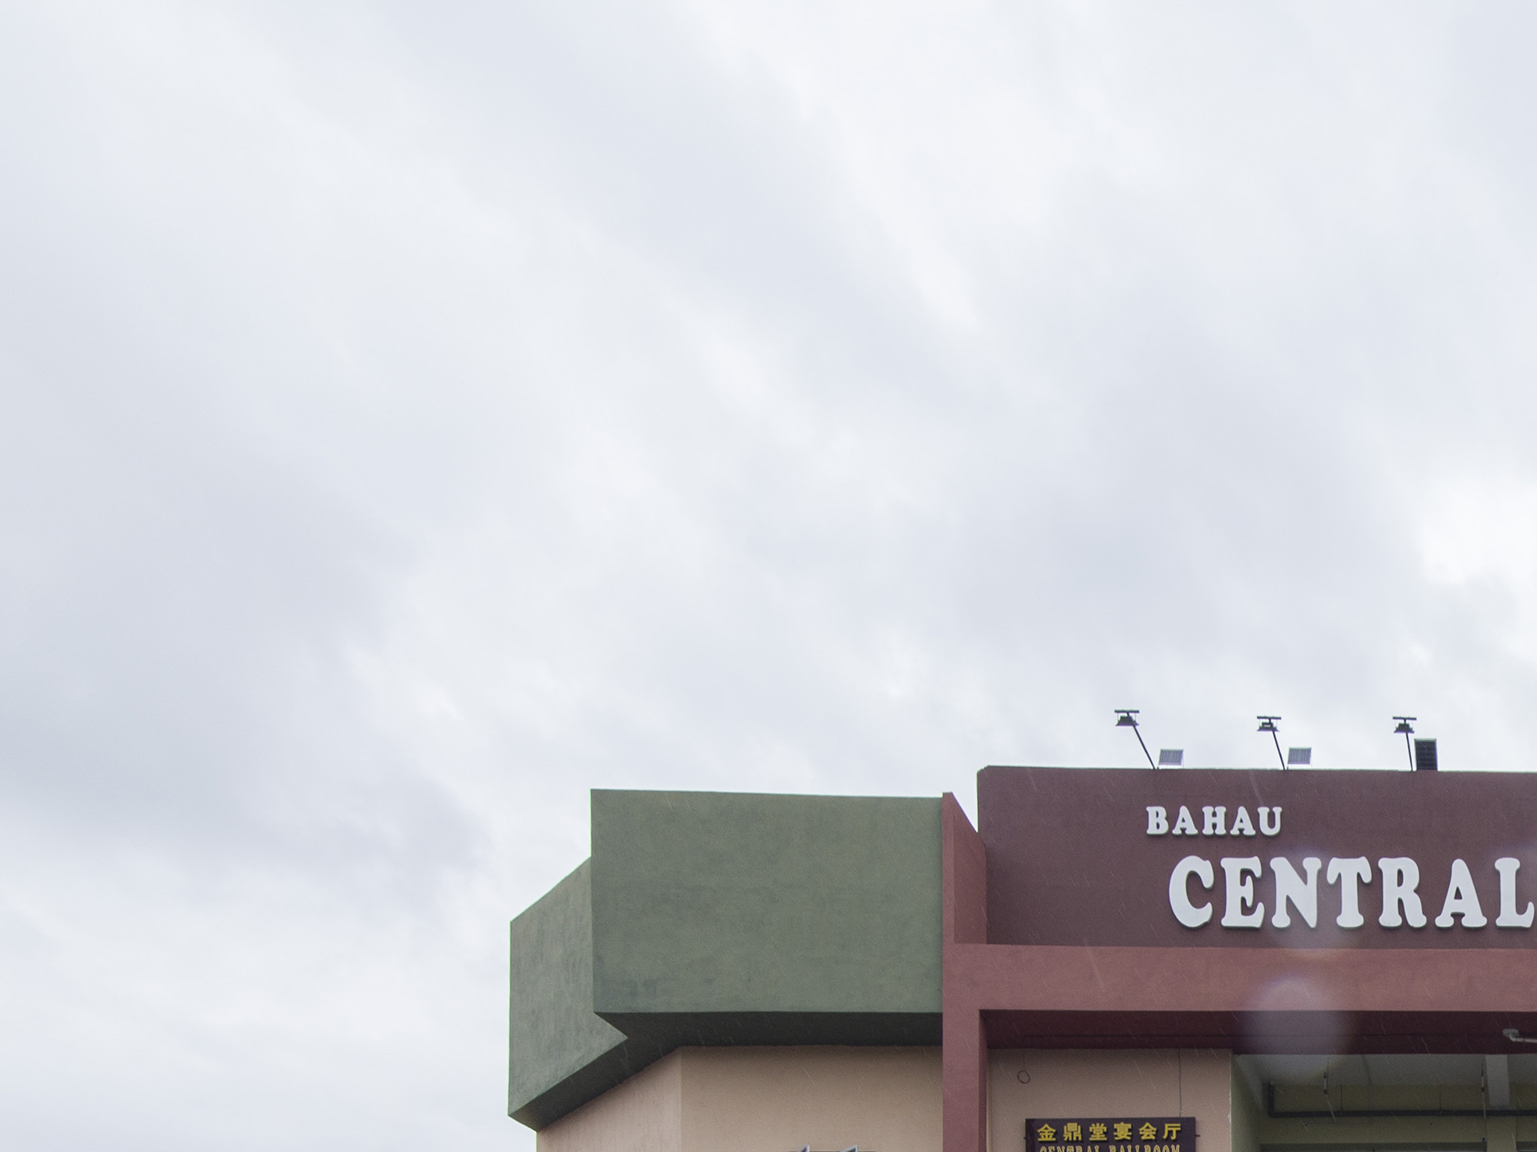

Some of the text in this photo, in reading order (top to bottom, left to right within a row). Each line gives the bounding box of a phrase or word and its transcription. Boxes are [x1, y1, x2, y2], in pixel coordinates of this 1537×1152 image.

[1146, 806, 1283, 836] BAHAU
[1168, 855, 1535, 929] CENTRAL
[1037, 1122, 1182, 1142] 金鼎堂宴会厅
